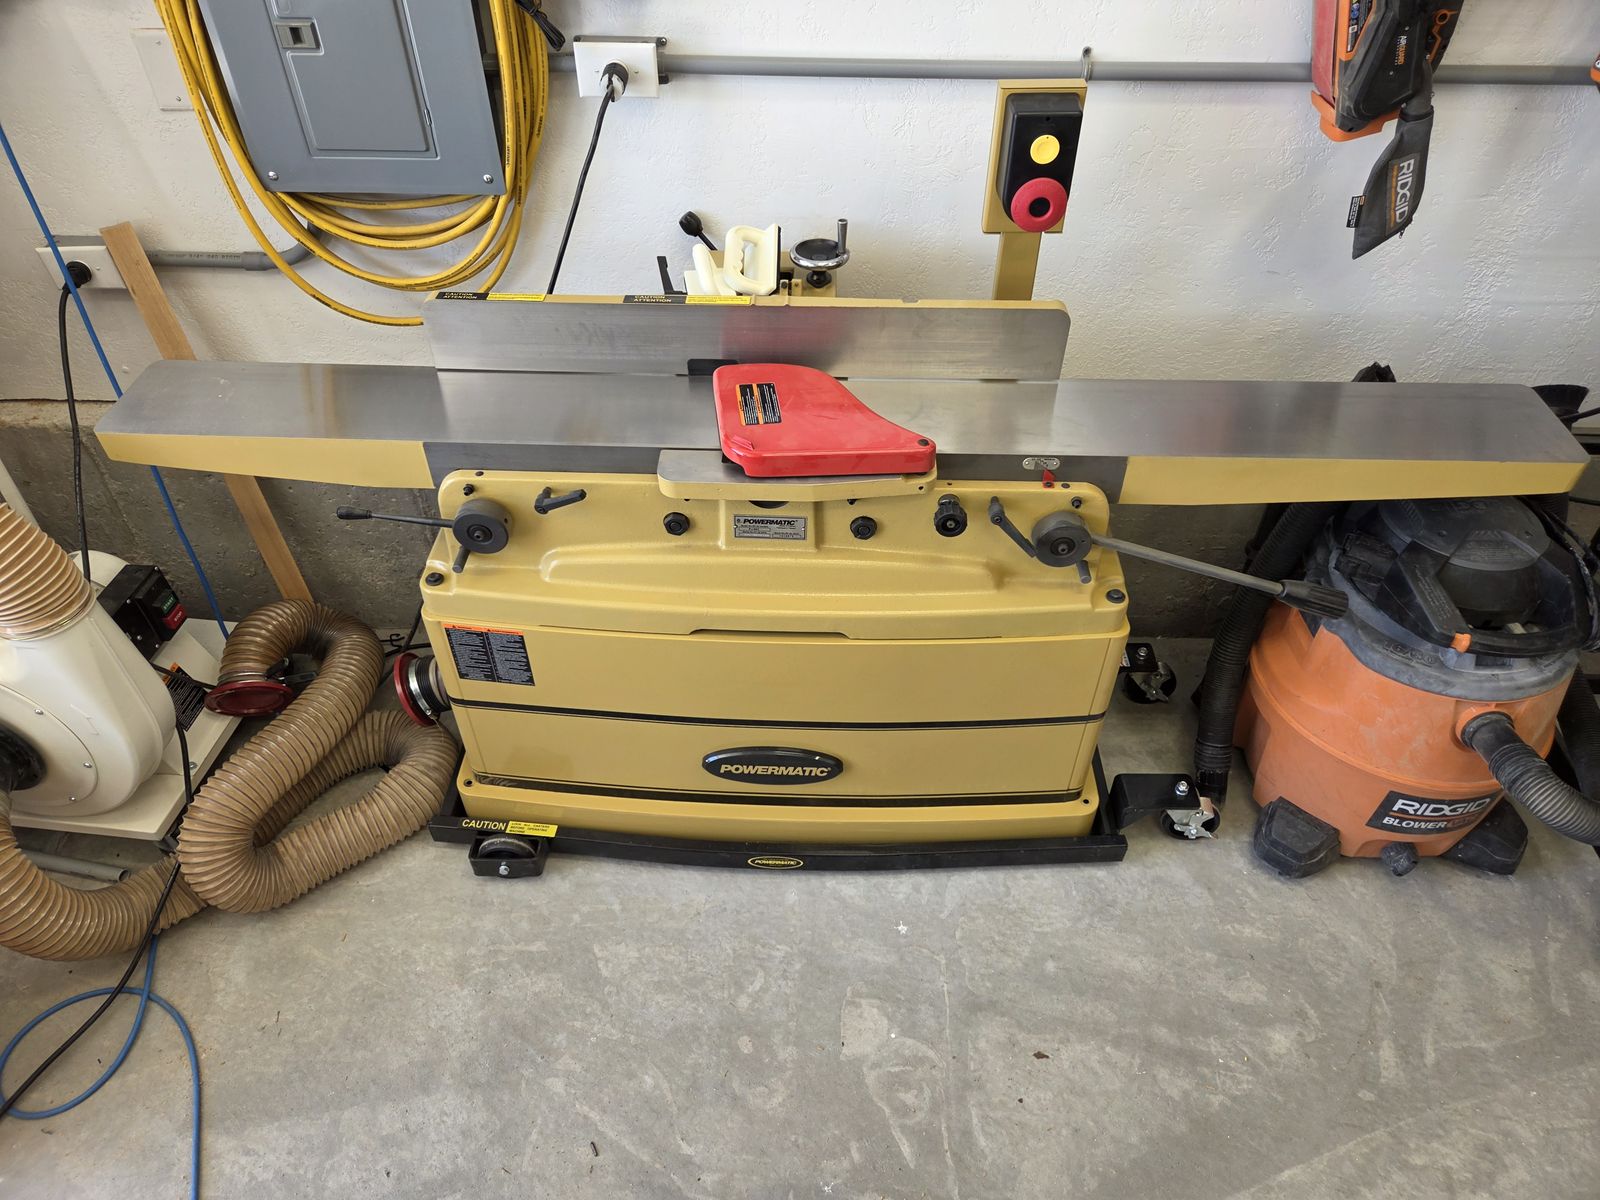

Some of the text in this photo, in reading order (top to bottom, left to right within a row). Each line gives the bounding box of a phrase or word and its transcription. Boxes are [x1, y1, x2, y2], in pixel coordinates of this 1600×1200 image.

[1395, 158, 1415, 223] RIDGID
[743, 518, 796, 526] POWERMATIC
[720, 764, 829, 777] POWERMATIC
[1391, 797, 1491, 816] RIDGID
[462, 819, 507, 831] CAUTION
[1382, 816, 1448, 829] BLOWER
